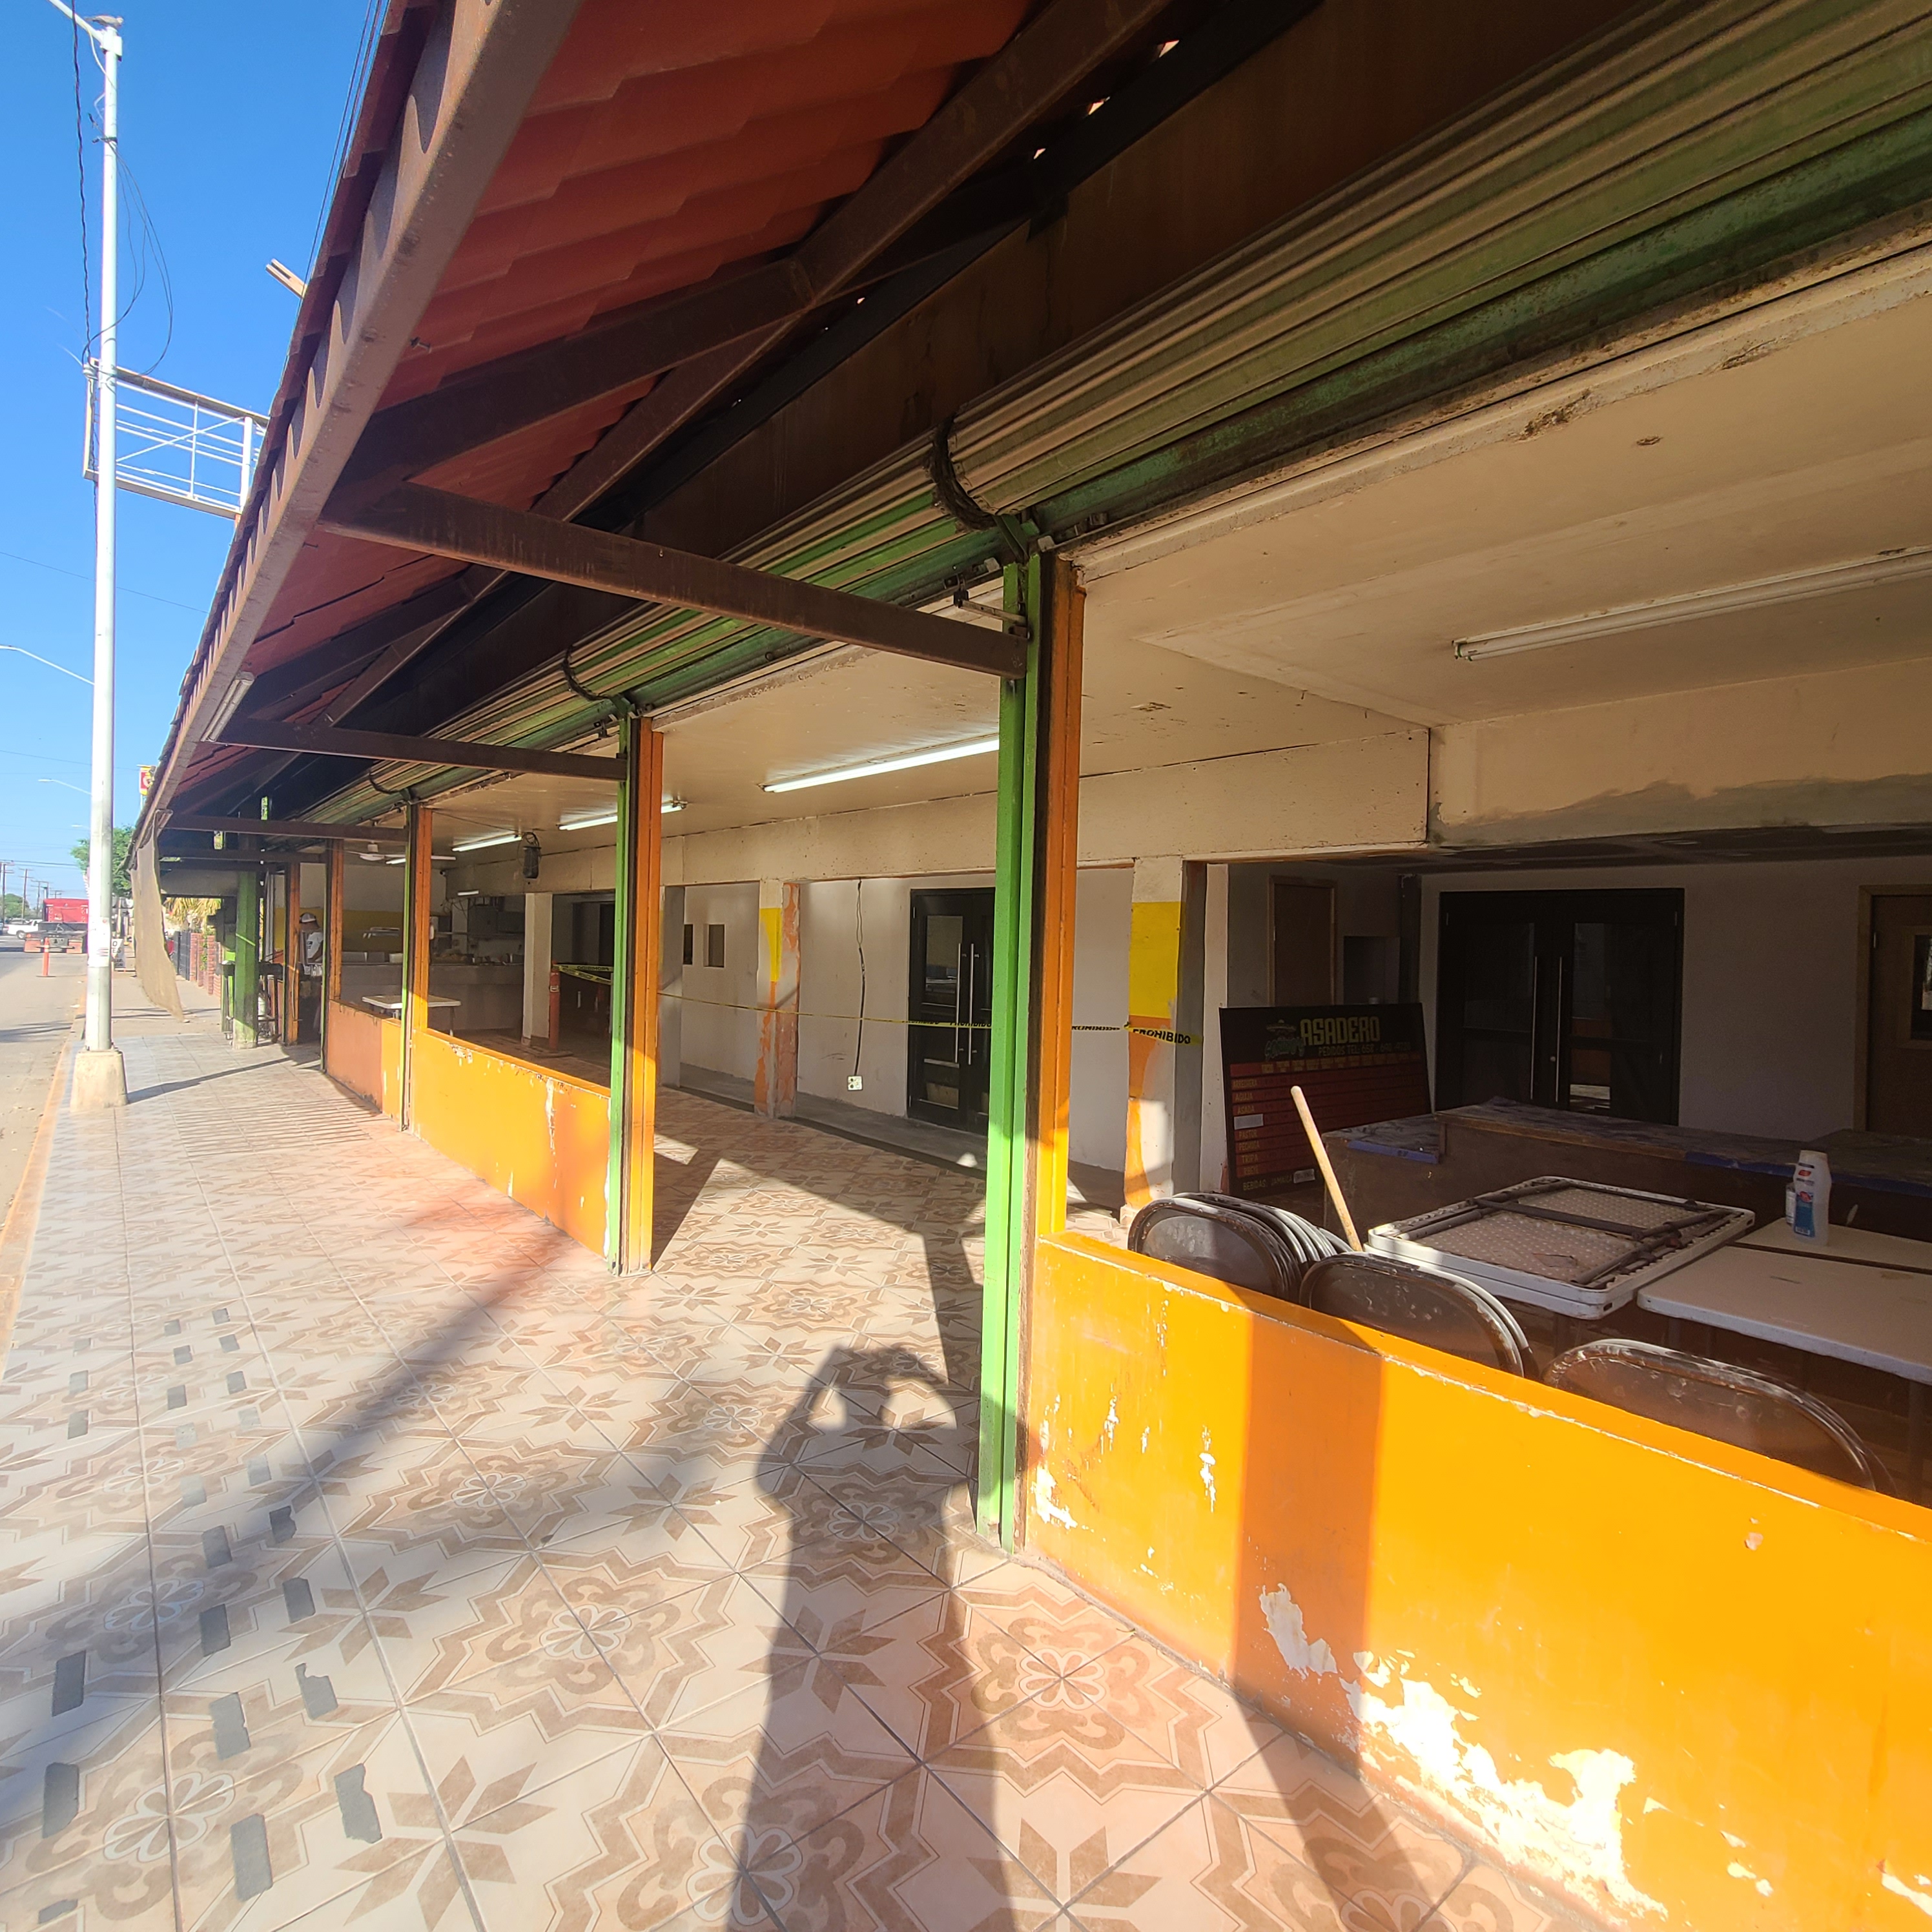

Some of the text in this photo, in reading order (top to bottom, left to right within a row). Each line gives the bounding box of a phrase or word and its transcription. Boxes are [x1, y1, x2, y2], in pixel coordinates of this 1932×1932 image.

[1300, 1016, 1380, 1045] ASADERO
[1133, 1029, 1191, 1044] PROHIBIDO
[1318, 1045, 1346, 1056] PEDIDOS
[1235, 1092, 1253, 1102] AGUJA
[1237, 1105, 1255, 1115] ASADA
[1241, 1154, 1259, 1164] TRIPA
